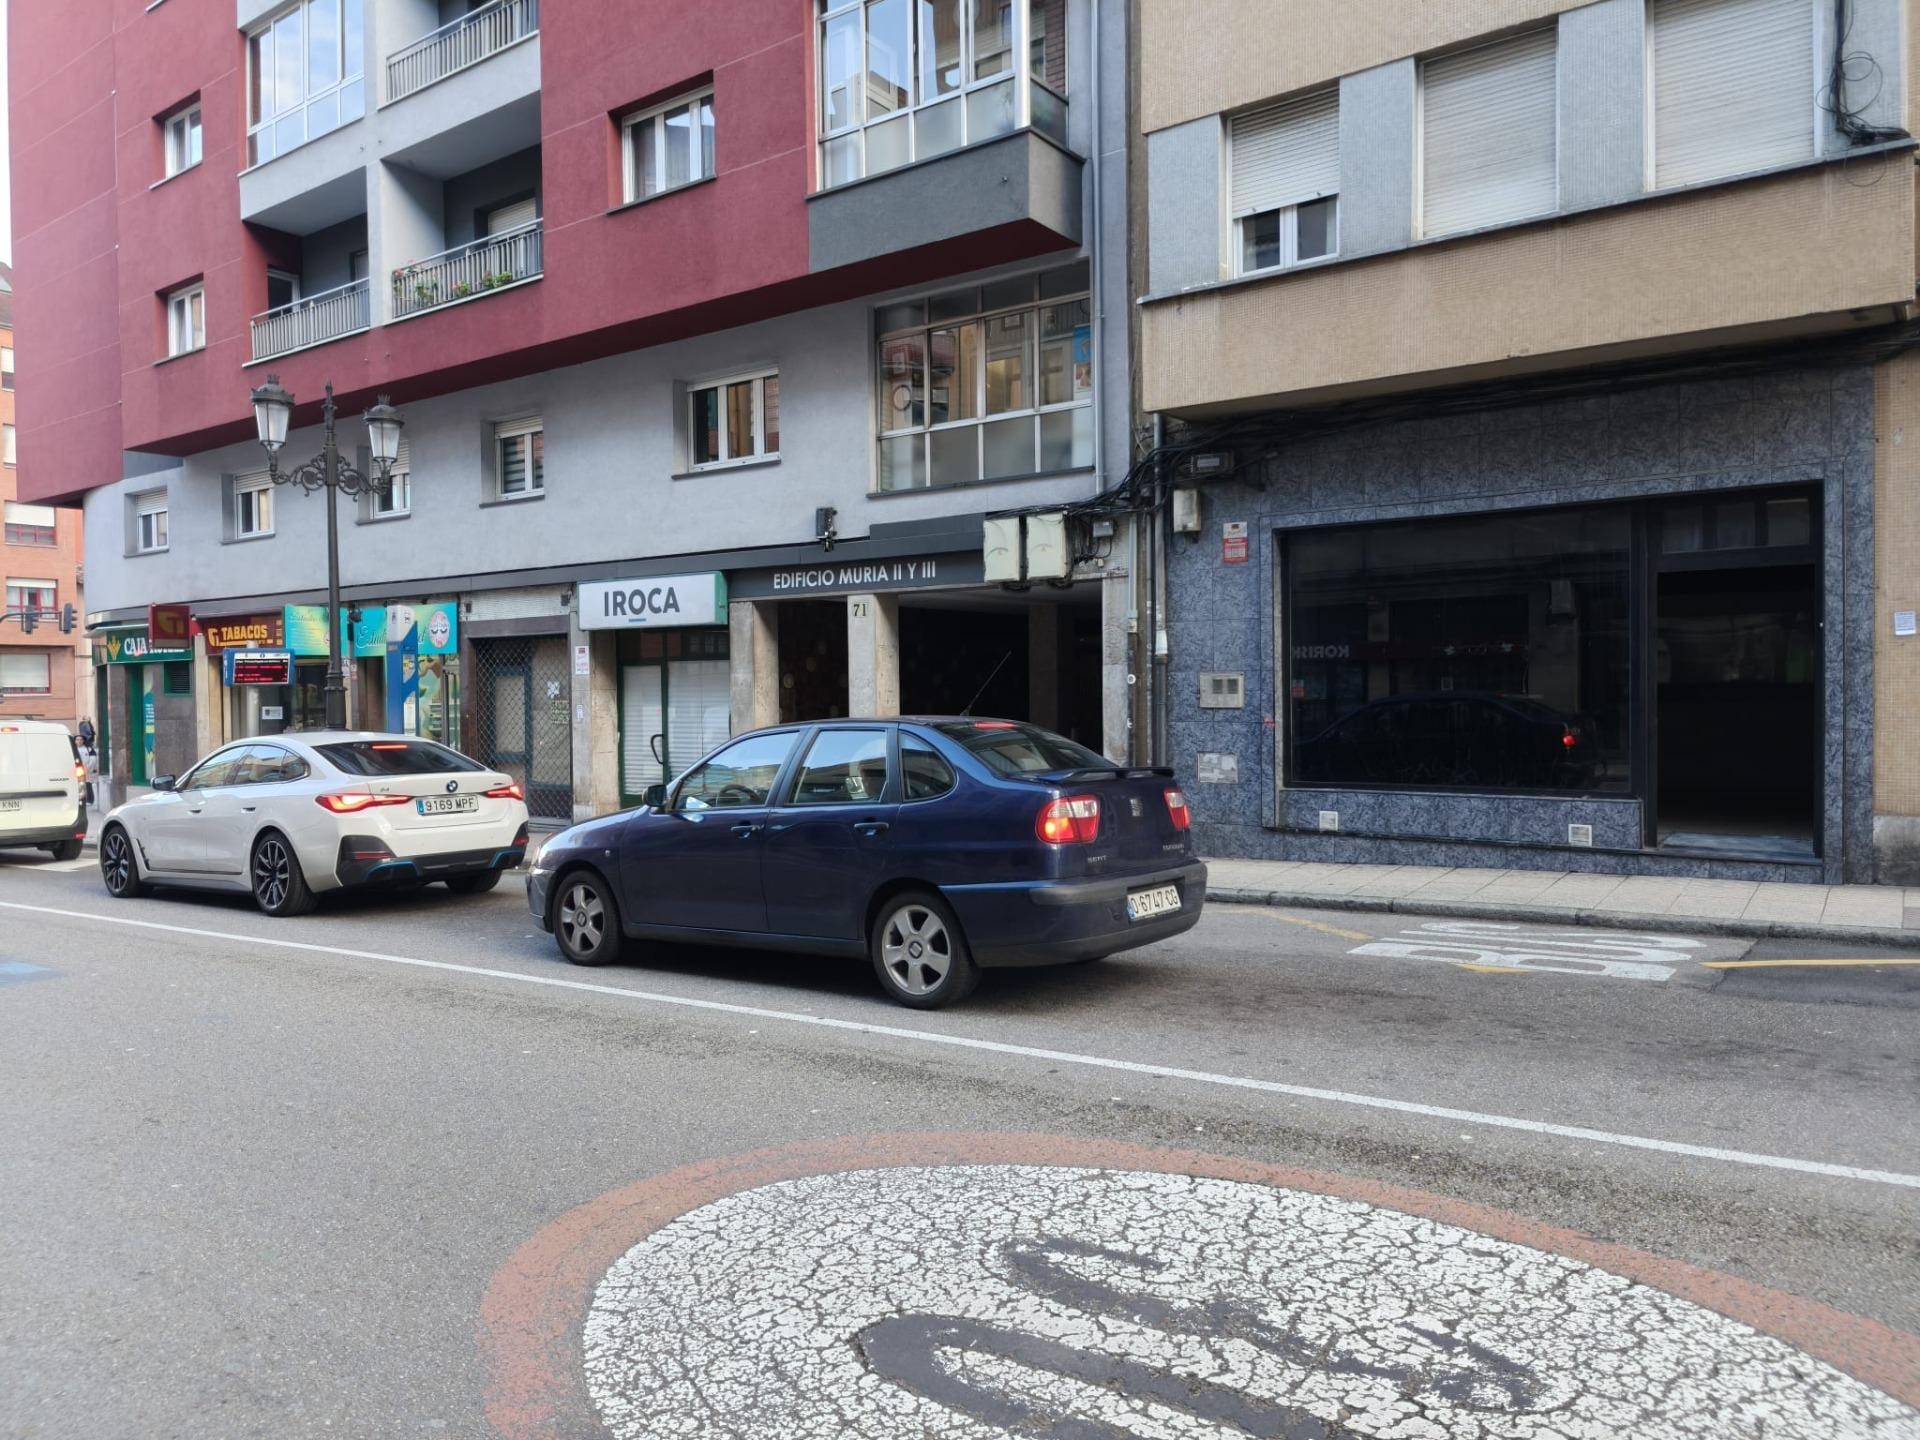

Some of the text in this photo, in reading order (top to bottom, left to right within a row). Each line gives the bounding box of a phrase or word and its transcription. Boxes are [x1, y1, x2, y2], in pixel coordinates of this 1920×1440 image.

[773, 561, 936, 589] EDIFICIO MURIA II Y III
[604, 586, 680, 616] IROCA
[853, 604, 866, 616] 71
[221, 624, 267, 641] TABACOS
[124, 637, 148, 656] CAJA
[425, 797, 474, 811] 9169 MPF
